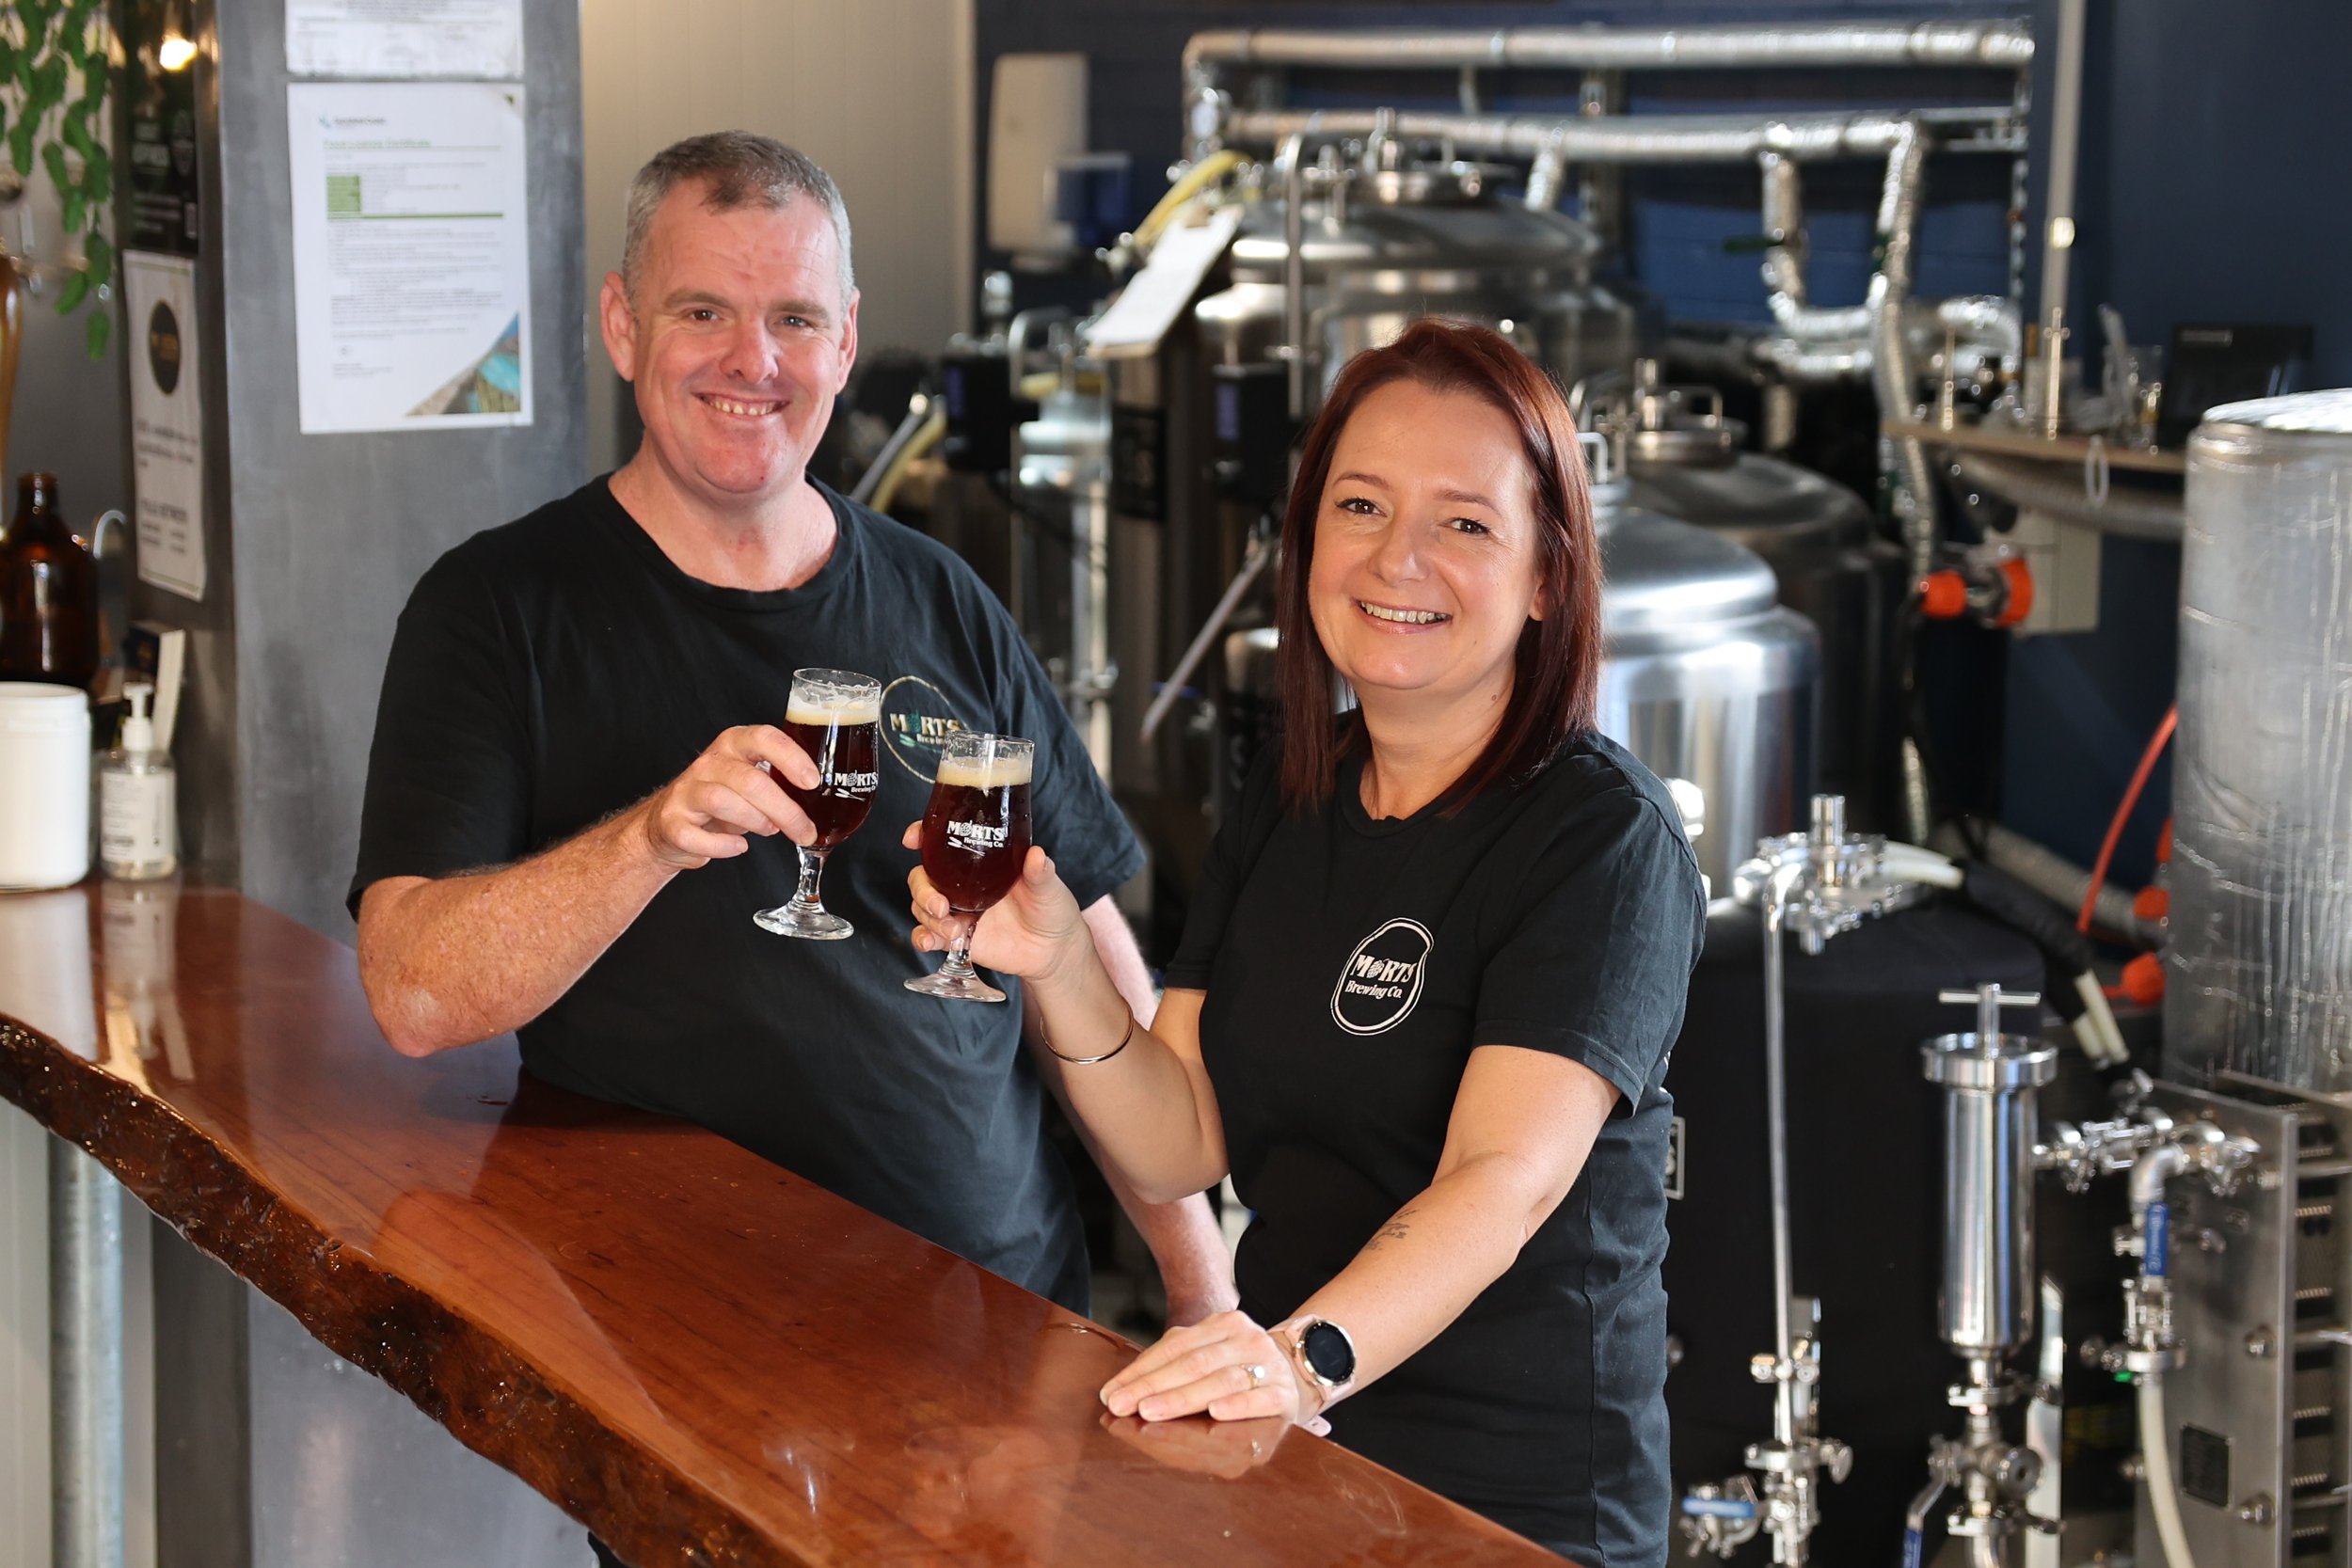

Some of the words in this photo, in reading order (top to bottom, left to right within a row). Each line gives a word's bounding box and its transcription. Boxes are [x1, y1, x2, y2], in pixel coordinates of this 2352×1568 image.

[963, 836, 993, 848] Brewing
[1345, 980, 1389, 1000] Brewing
[1387, 985, 1402, 999] Co.
